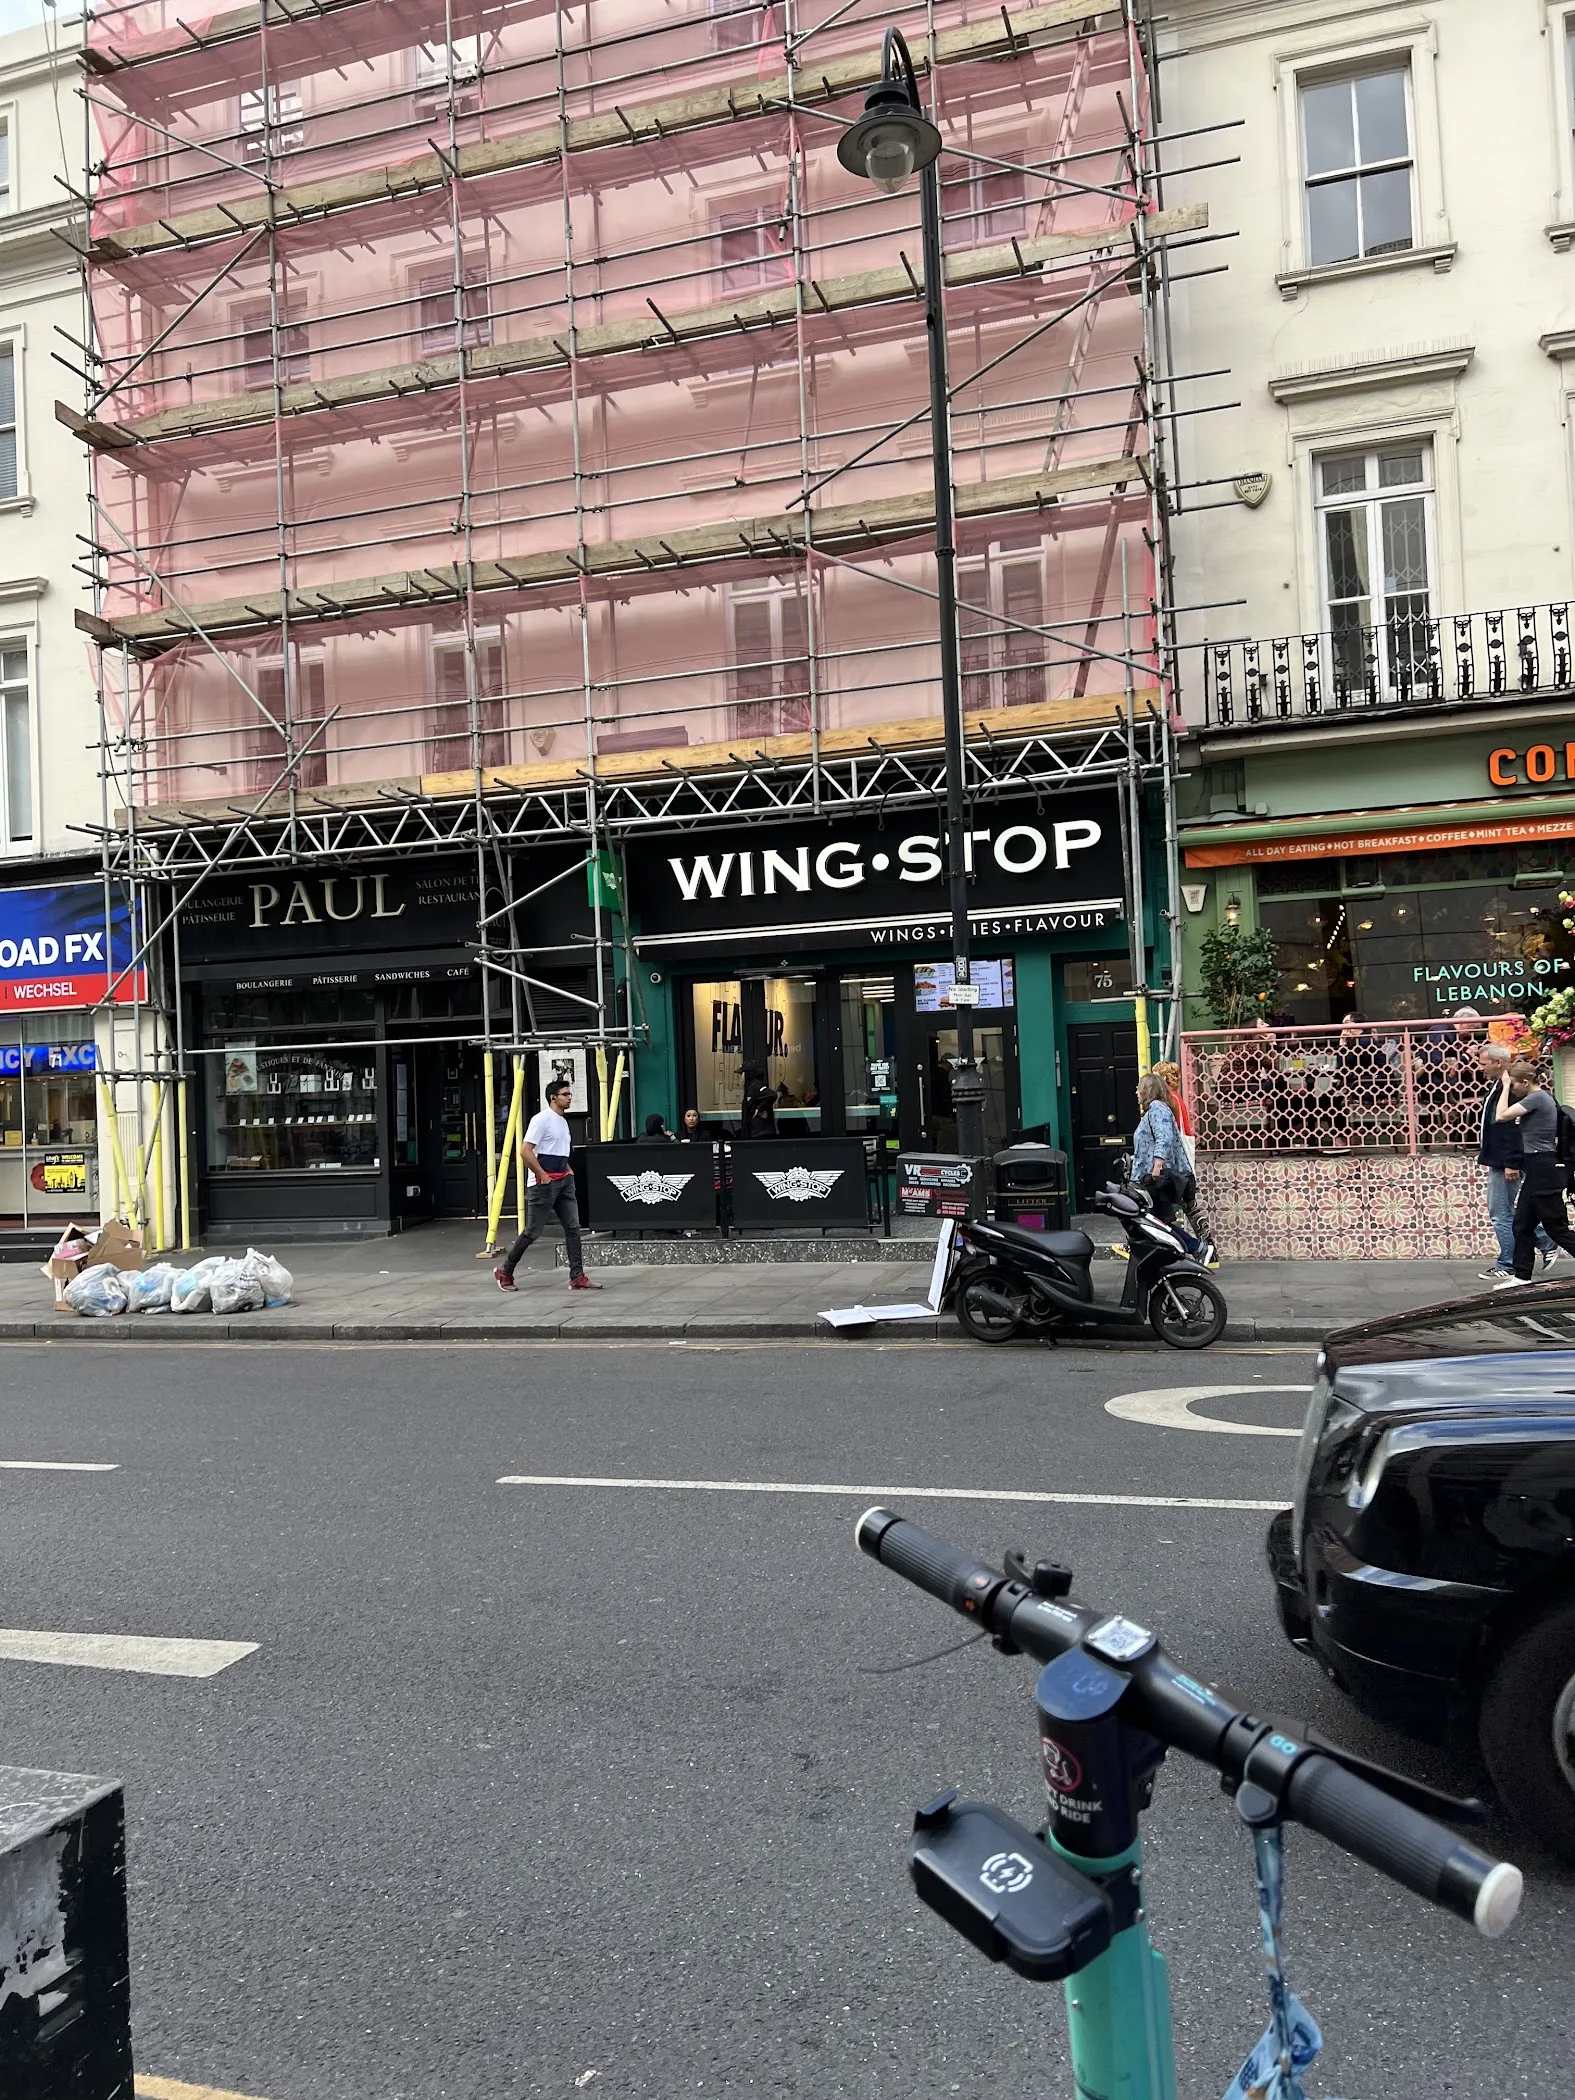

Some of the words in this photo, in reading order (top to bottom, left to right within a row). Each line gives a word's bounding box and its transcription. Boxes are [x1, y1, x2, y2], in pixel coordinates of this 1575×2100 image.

[1489, 741, 1575, 786] CO
[1246, 848, 1264, 857] ALL
[1267, 846, 1286, 856] DAY
[1289, 843, 1326, 854] EATING
[1334, 840, 1354, 850] HOT
[1357, 835, 1417, 848] BREAKFAST
[1426, 831, 1467, 843] COFFEE
[1476, 828, 1502, 839] MINT
[1505, 826, 1527, 836] TEA
[1537, 822, 1574, 834] MEZZE
[416, 878, 450, 890] SALON
[454, 875, 468, 886] DE
[180, 896, 245, 910] OULANGERIE
[248, 874, 407, 928] PAUL
[418, 891, 480, 905] RESTAURAN
[65, 932, 104, 963] FX
[236, 979, 293, 990] BOULANGERIE
[313, 975, 358, 985] PÂTISSERIE
[375, 970, 430, 981] SANDWICHES
[447, 967, 470, 977] CAFÉ
[1413, 960, 1525, 982] FLAVOURS
[1534, 958, 1564, 975] OF
[13, 982, 77, 999] WECHSEL
[1094, 974, 1113, 988] 75
[1436, 982, 1543, 1002] LEBANON
[0, 1047, 36, 1069] CY
[50, 1053, 62, 1067] 71
[292, 1056, 300, 1064] ET
[303, 1057, 313, 1065] DE
[904, 1163, 921, 1176] VR
[1270, 1735, 1297, 1755] GO
[1060, 1794, 1103, 1812] DRINK
[1061, 1805, 1091, 1824] RIDE
